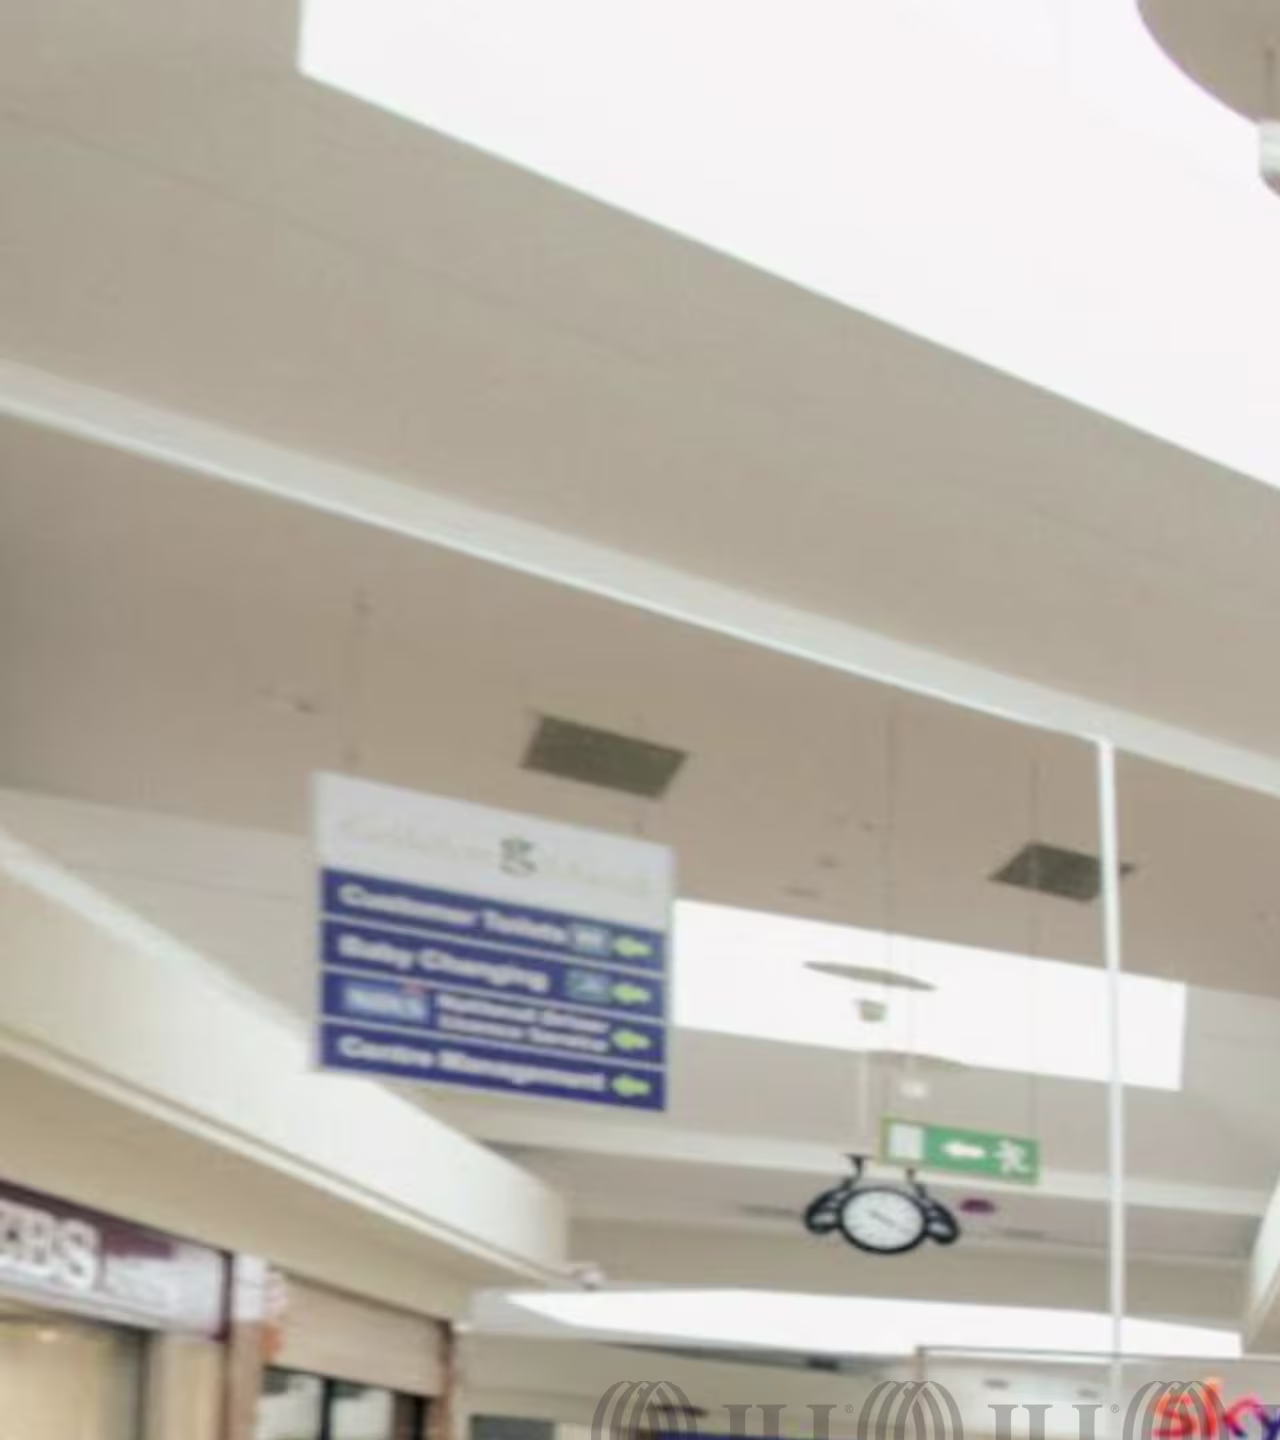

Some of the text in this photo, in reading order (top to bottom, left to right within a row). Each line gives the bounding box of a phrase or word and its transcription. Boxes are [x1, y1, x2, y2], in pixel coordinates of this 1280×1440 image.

[337, 883, 568, 943] Customer Toilets
[337, 934, 550, 993] Baby Changing
[337, 1036, 606, 1091] Centre Management
